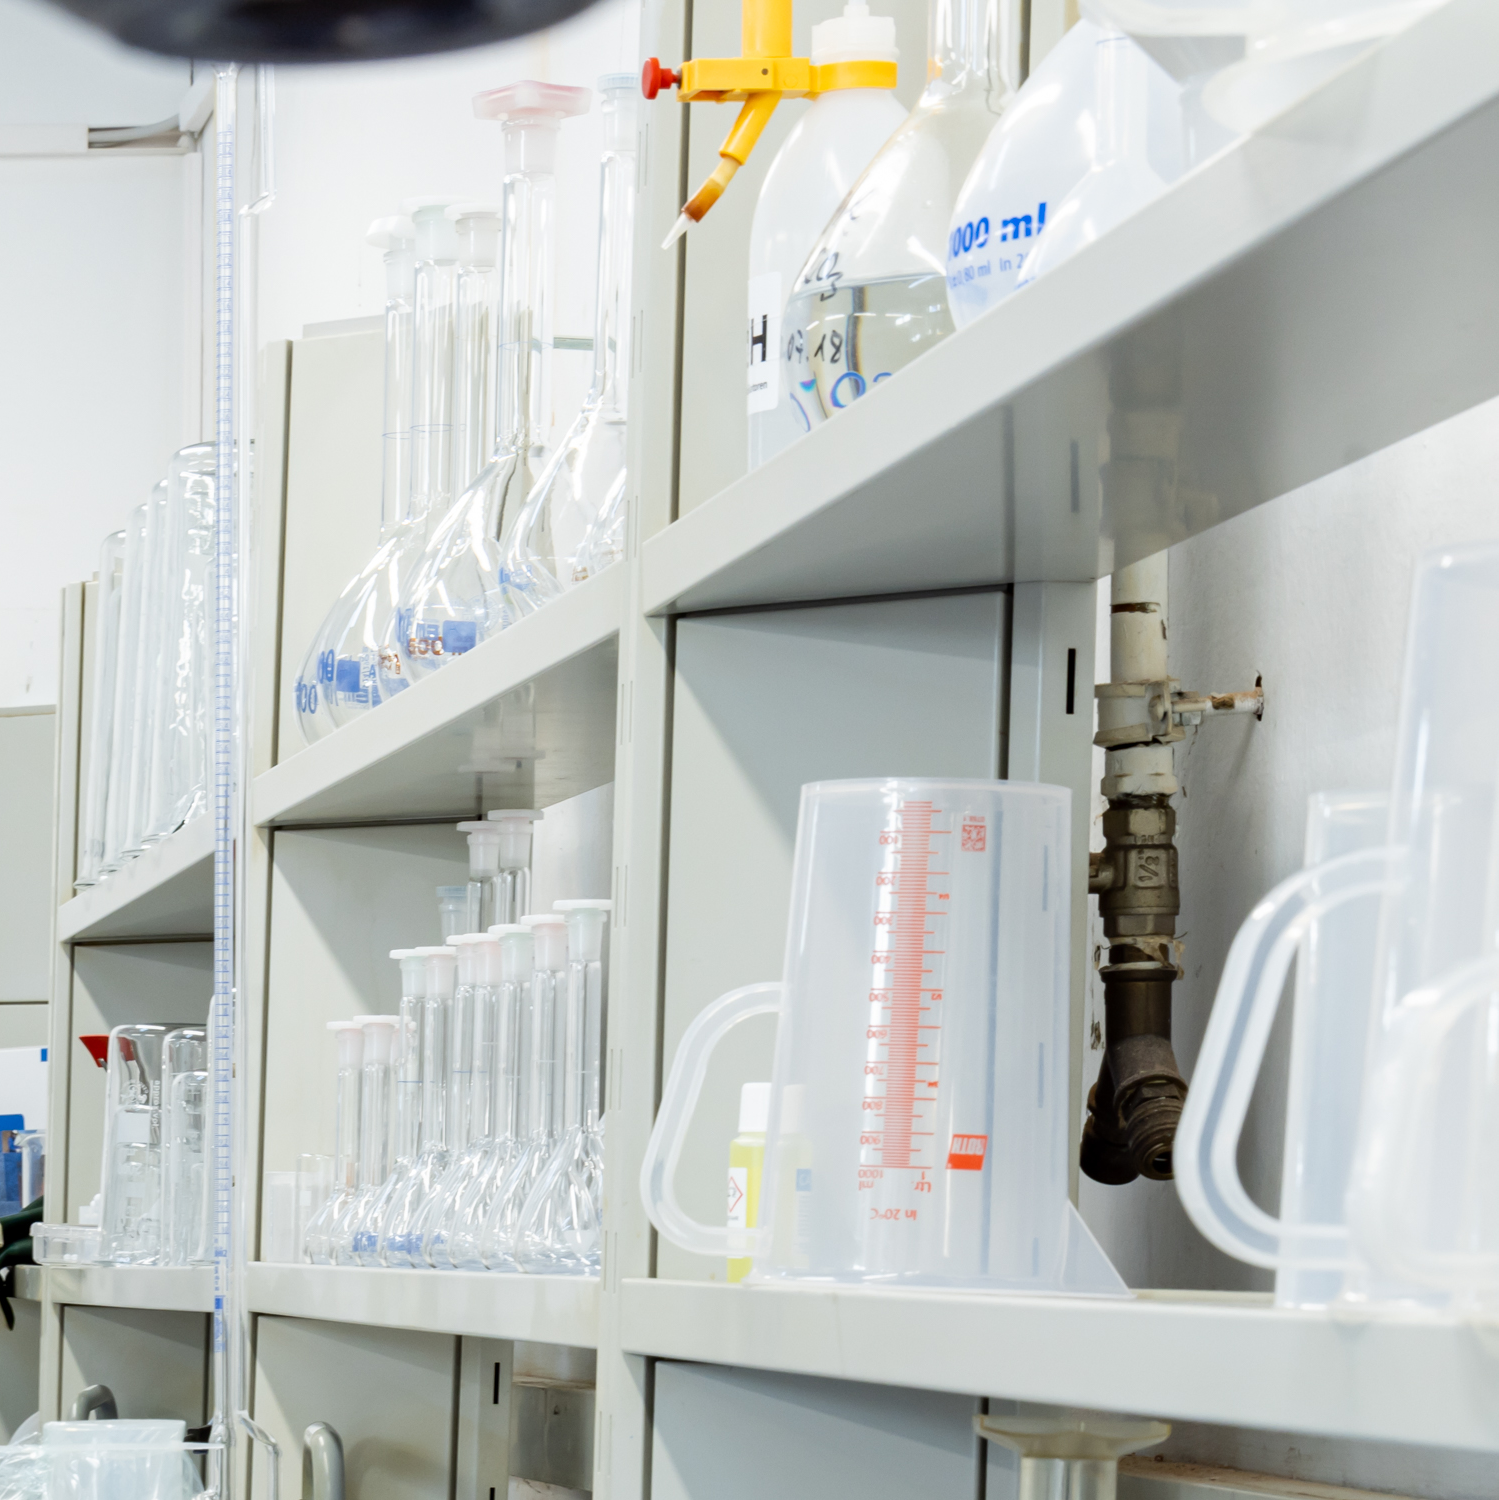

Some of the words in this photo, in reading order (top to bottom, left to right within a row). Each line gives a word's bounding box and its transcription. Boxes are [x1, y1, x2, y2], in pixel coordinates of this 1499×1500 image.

[949, 217, 989, 261] 000
[1000, 202, 1047, 242] ml
[747, 314, 767, 366] H
[858, 1169, 883, 1179] 1000
[858, 1180, 875, 1191] ml
